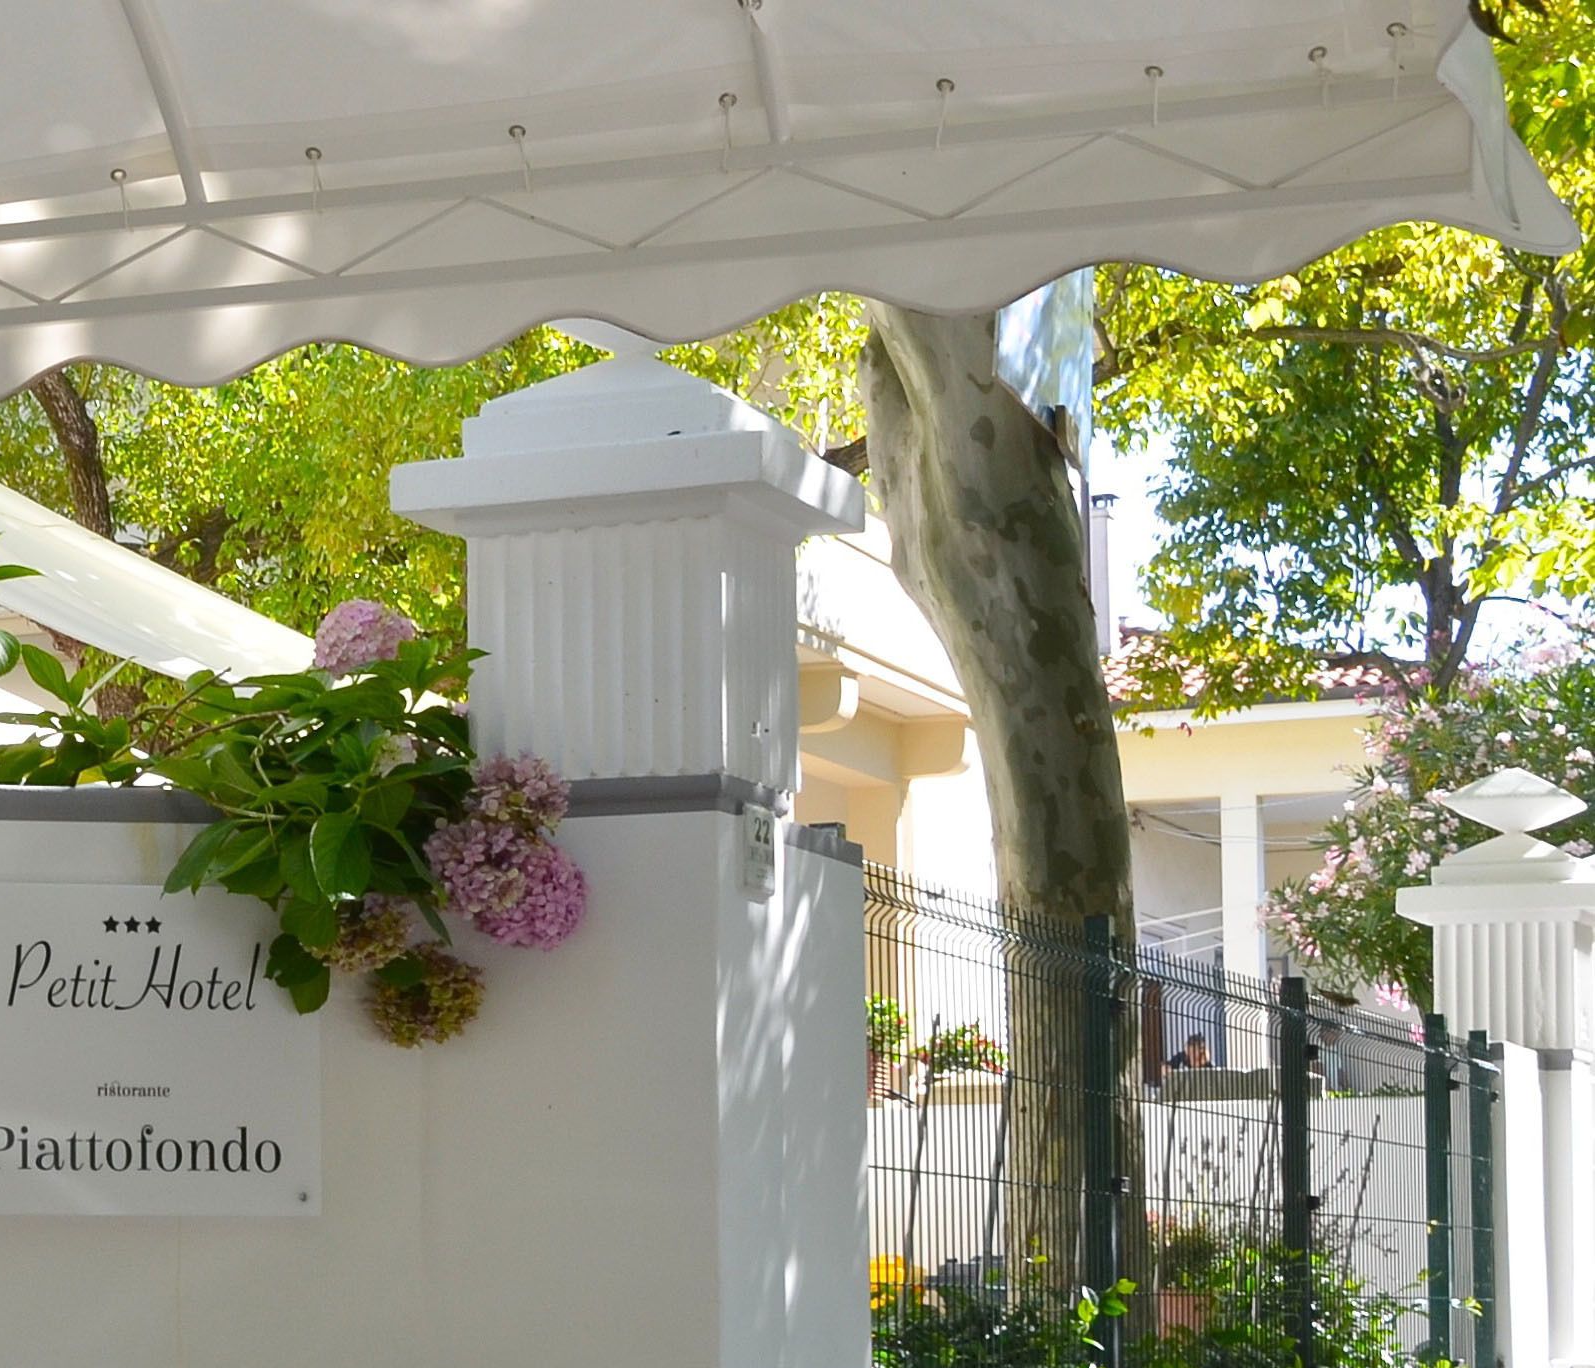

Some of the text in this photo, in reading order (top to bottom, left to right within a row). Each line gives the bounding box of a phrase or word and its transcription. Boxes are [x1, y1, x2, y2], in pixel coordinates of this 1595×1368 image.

[754, 817, 770, 844] 22
[8, 940, 261, 1011] Petit Hotel
[97, 1080, 171, 1098] ristorante
